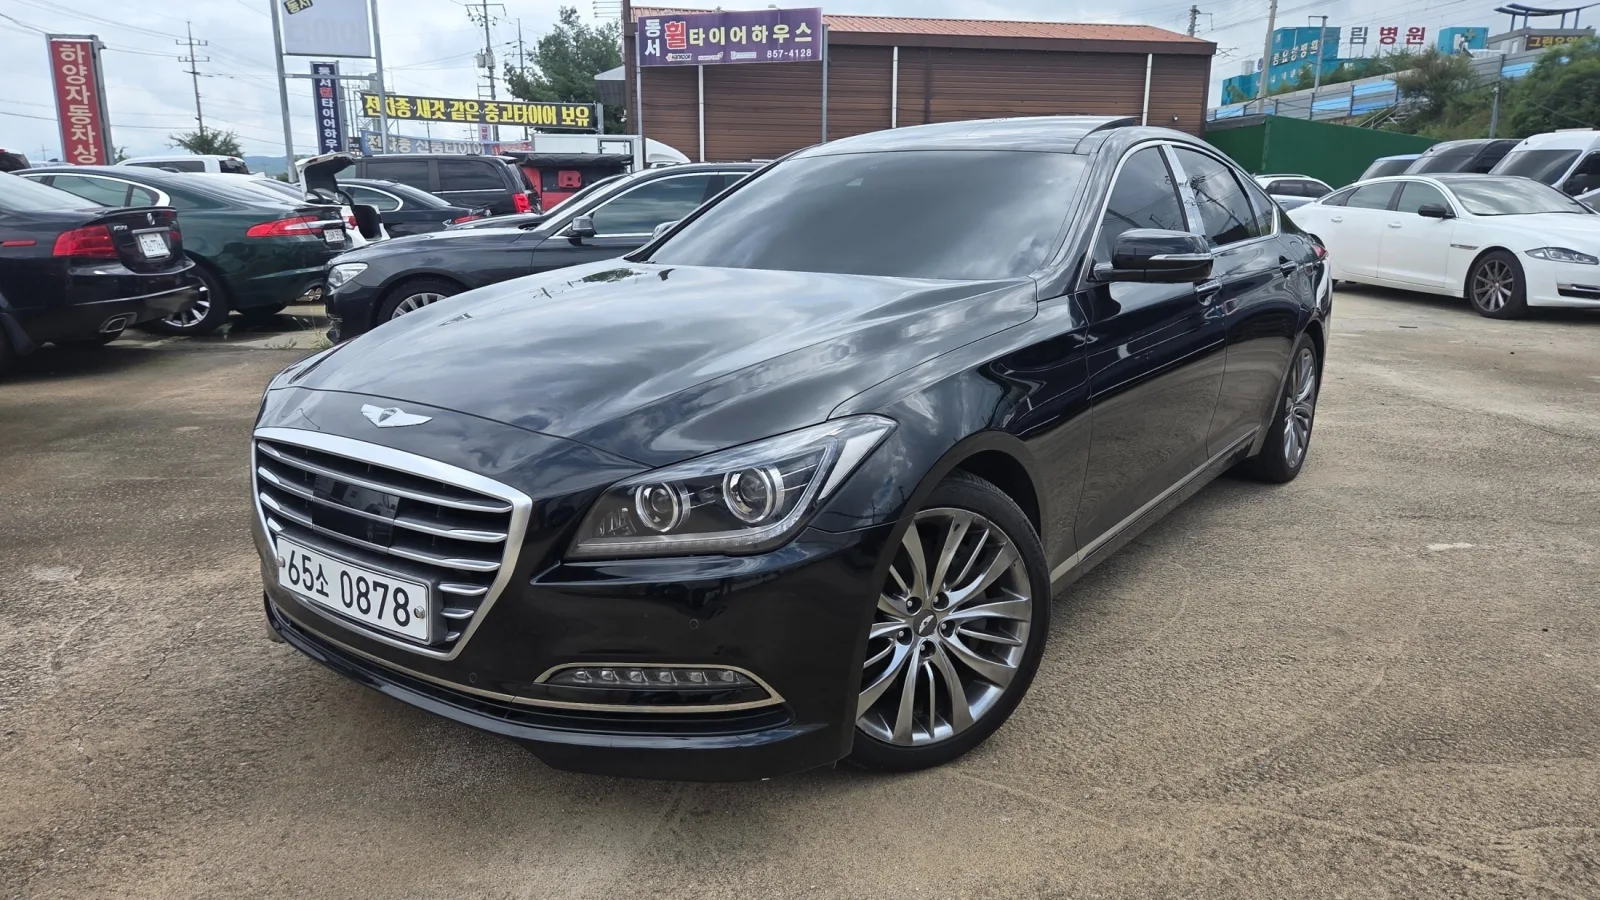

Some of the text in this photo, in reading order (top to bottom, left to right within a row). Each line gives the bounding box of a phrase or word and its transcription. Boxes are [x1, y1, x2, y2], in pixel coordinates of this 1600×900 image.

[645, 19, 661, 56] 동서
[767, 48, 812, 58] 857-4128
[59, 44, 98, 164] 하양자동차상
[364, 95, 590, 127] 전차종 새것 같은 중고타이어 보유
[288, 550, 411, 627] 65소 0878
